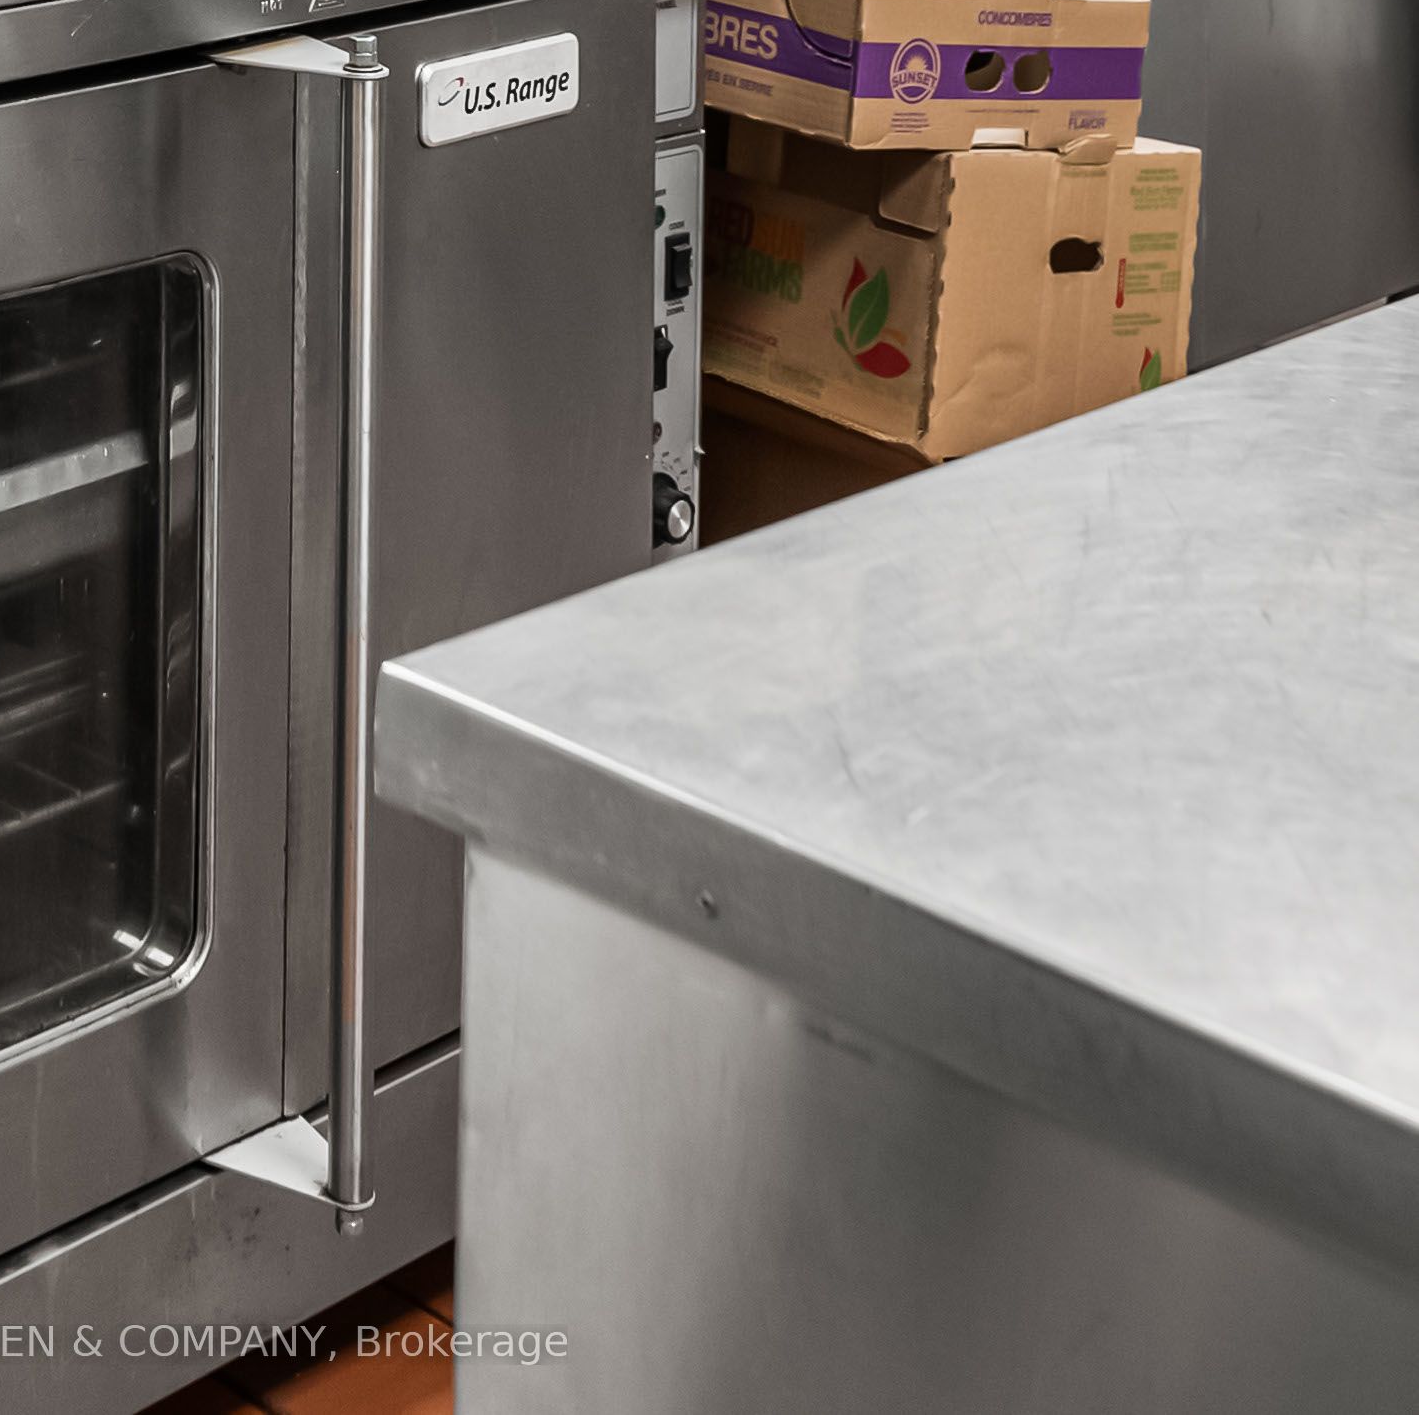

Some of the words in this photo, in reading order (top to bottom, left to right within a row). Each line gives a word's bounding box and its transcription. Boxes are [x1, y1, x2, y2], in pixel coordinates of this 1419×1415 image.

[977, 9, 1054, 29] CONCOMBRES
[705, 10, 779, 63] BRES
[464, 82, 502, 115] U.S.
[505, 70, 571, 106] Range
[891, 71, 939, 91] SUNSET
